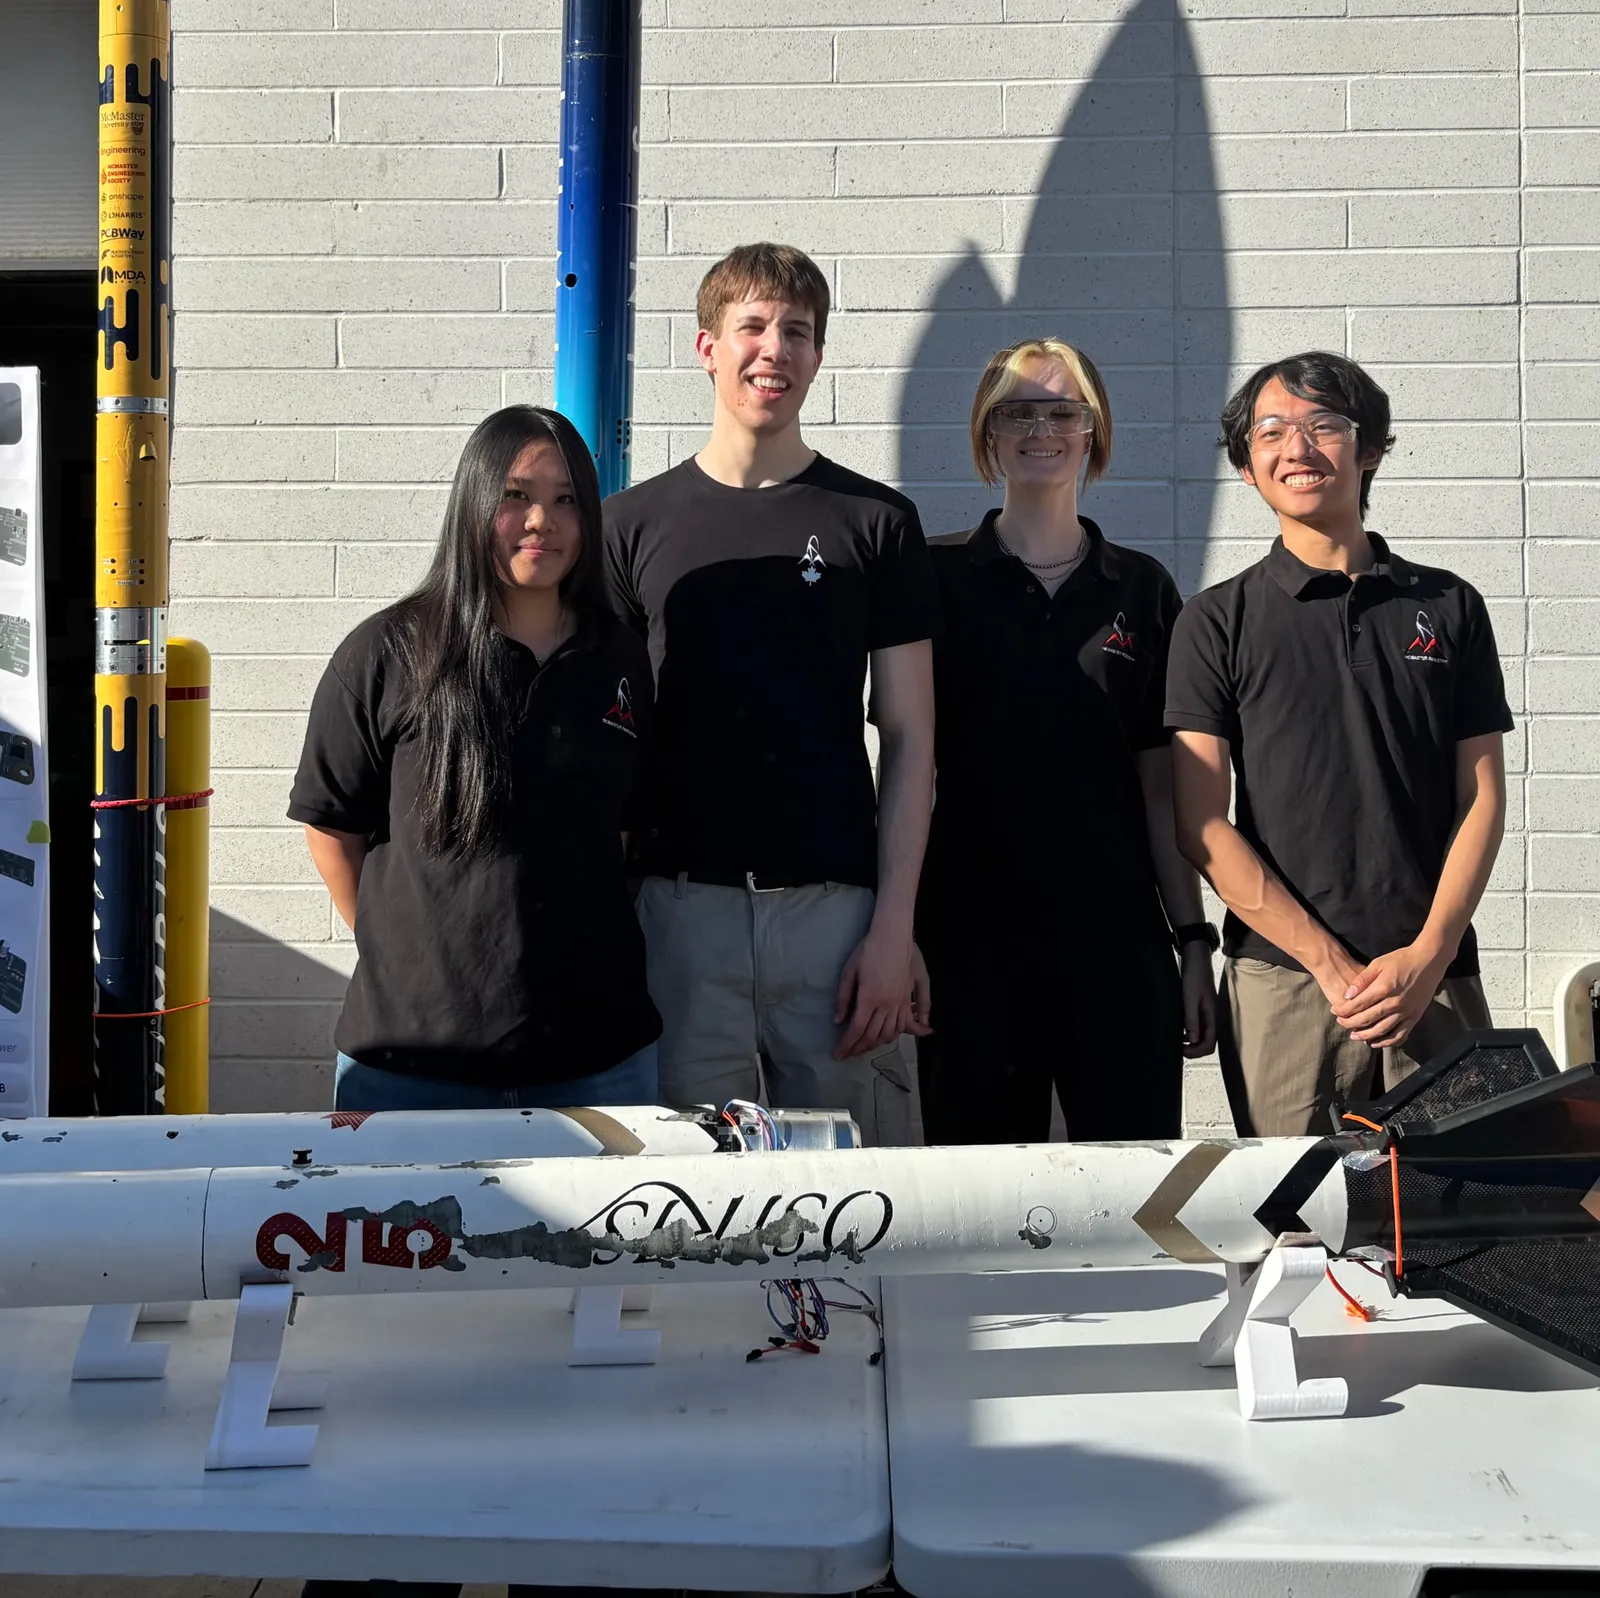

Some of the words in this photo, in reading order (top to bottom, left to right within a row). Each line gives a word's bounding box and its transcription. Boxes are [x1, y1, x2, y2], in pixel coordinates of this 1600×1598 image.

[101, 111, 145, 121] McMaster
[101, 228, 145, 240] PCBWay
[114, 270, 146, 280] MDA
